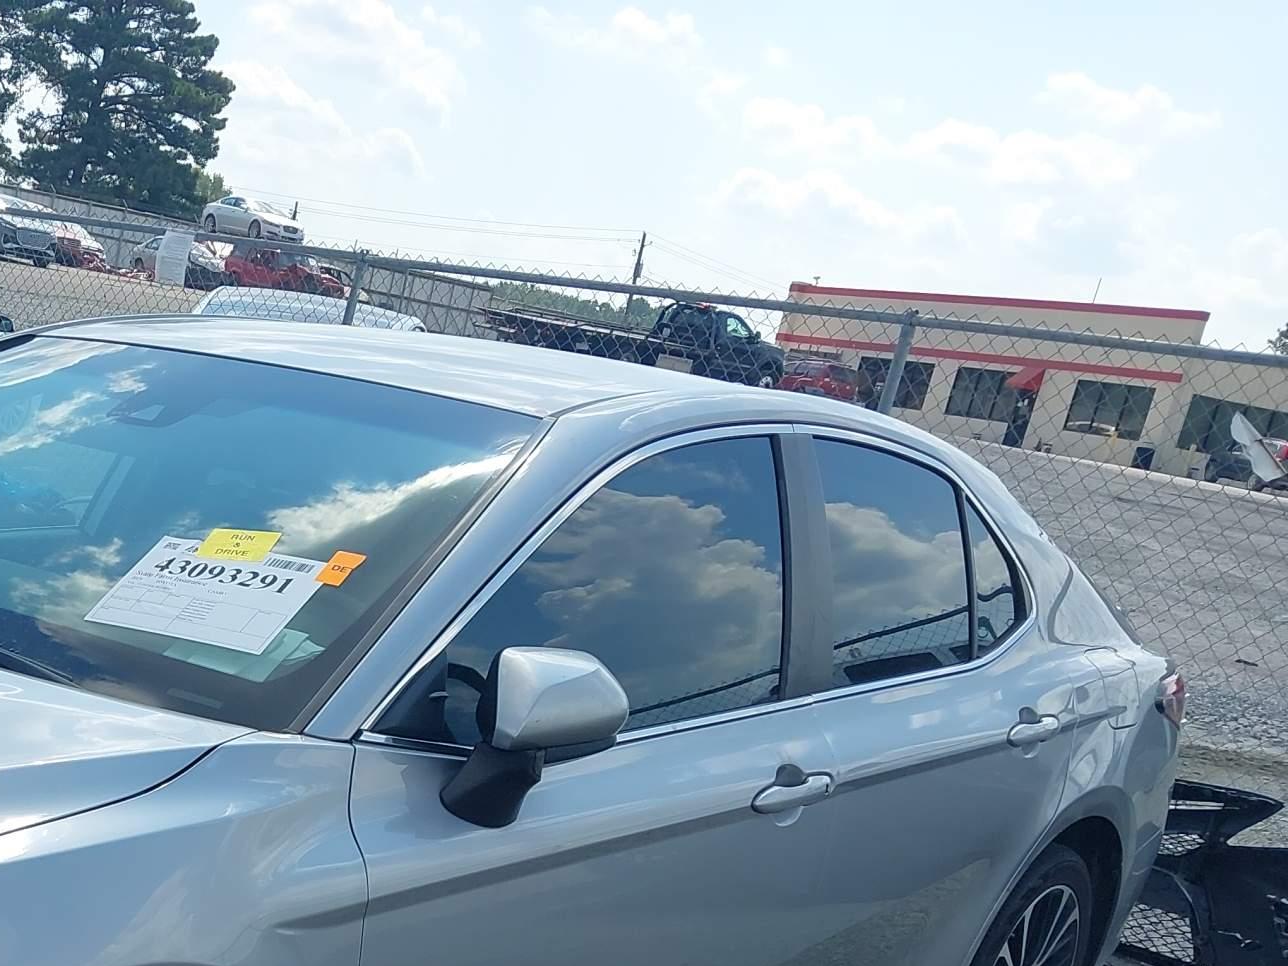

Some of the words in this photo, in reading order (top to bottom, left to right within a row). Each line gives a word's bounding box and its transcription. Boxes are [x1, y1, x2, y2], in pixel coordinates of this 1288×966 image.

[214, 548, 250, 557] DRIVE
[153, 556, 295, 595] 43093291
[173, 576, 209, 587] Insurance
